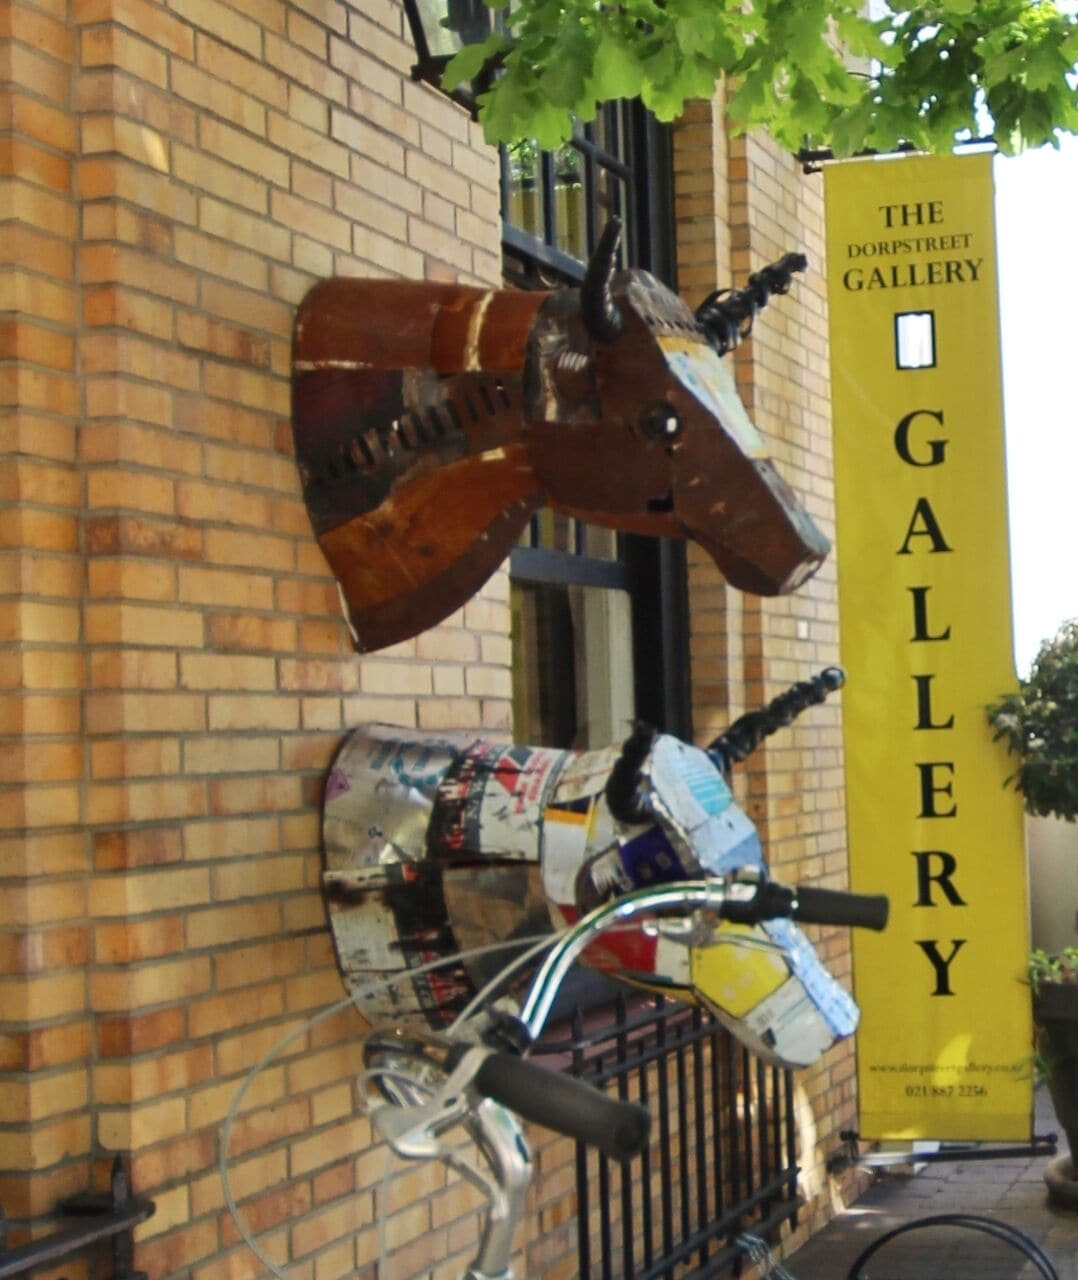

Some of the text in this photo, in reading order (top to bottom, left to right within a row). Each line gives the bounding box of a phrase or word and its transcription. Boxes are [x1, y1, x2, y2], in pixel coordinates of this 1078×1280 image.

[878, 201, 945, 228] THE
[847, 233, 973, 259] DORPSTREET
[842, 258, 984, 292] GALLERY
[894, 409, 968, 996] GALLERY
